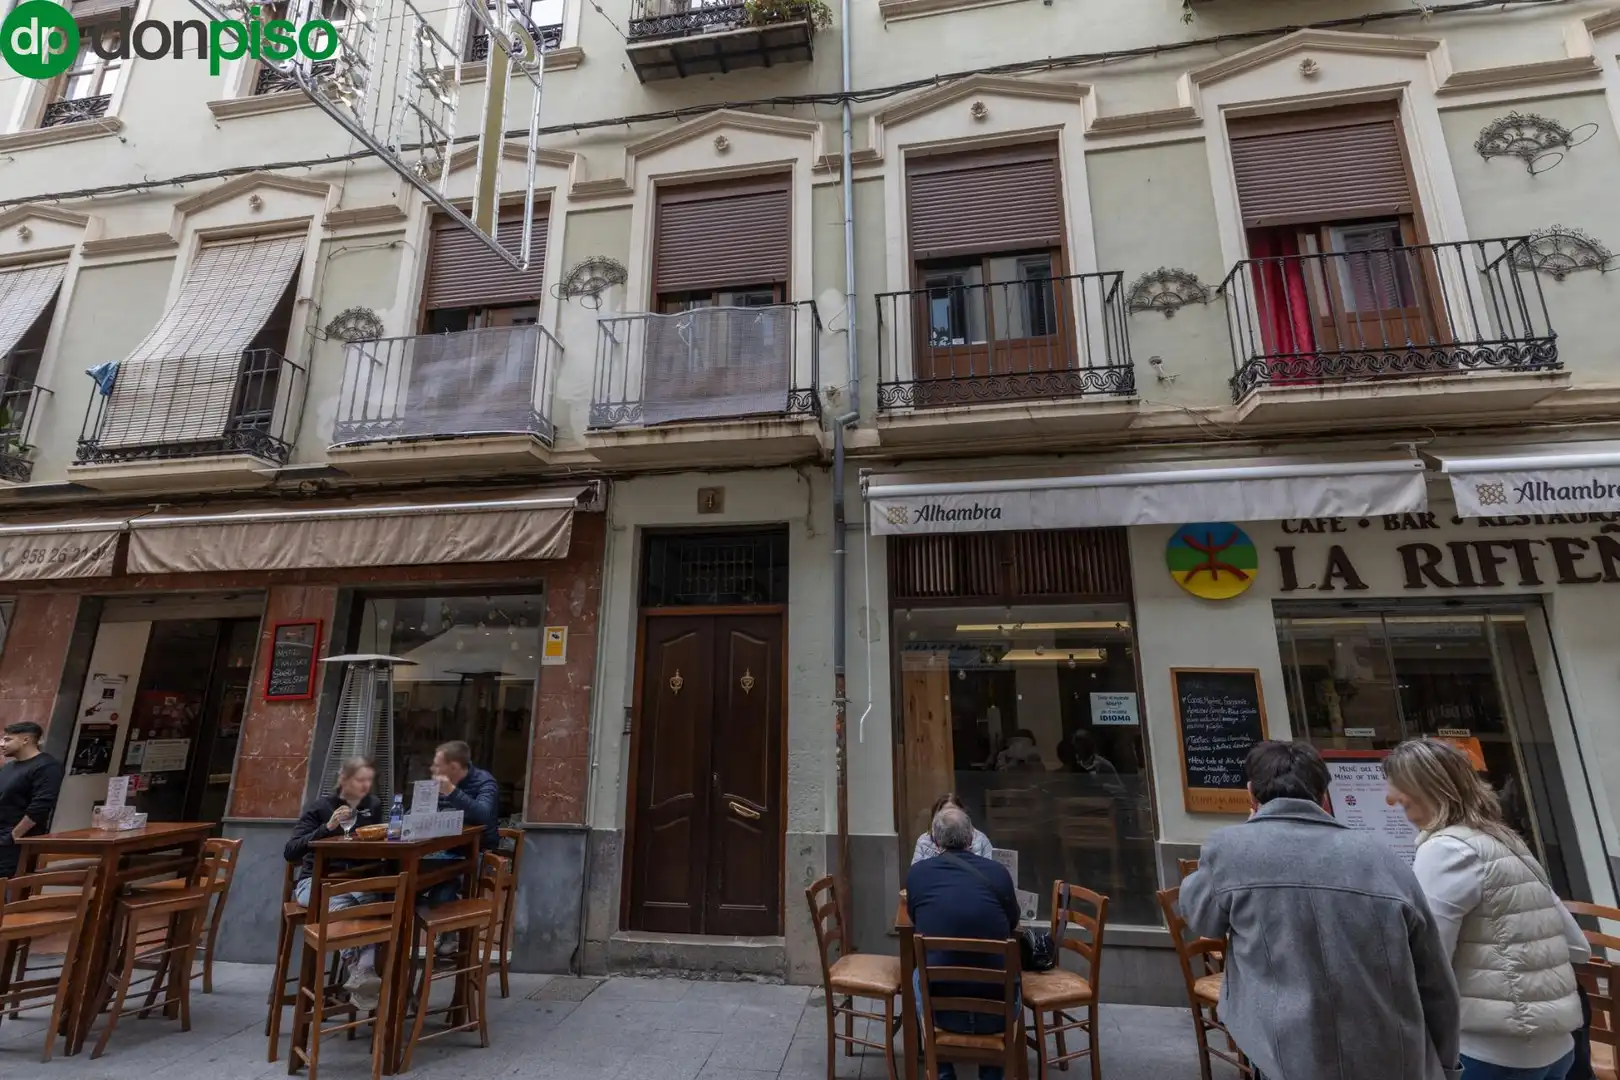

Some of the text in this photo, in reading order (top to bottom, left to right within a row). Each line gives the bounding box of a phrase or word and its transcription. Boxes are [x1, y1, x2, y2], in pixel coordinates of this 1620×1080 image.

[913, 503, 1002, 524] Alhambra
[1384, 511, 1441, 531] BAR
[20, 548, 46, 564] 958
[48, 547, 68, 564] 26
[1274, 545, 1370, 592] LA
